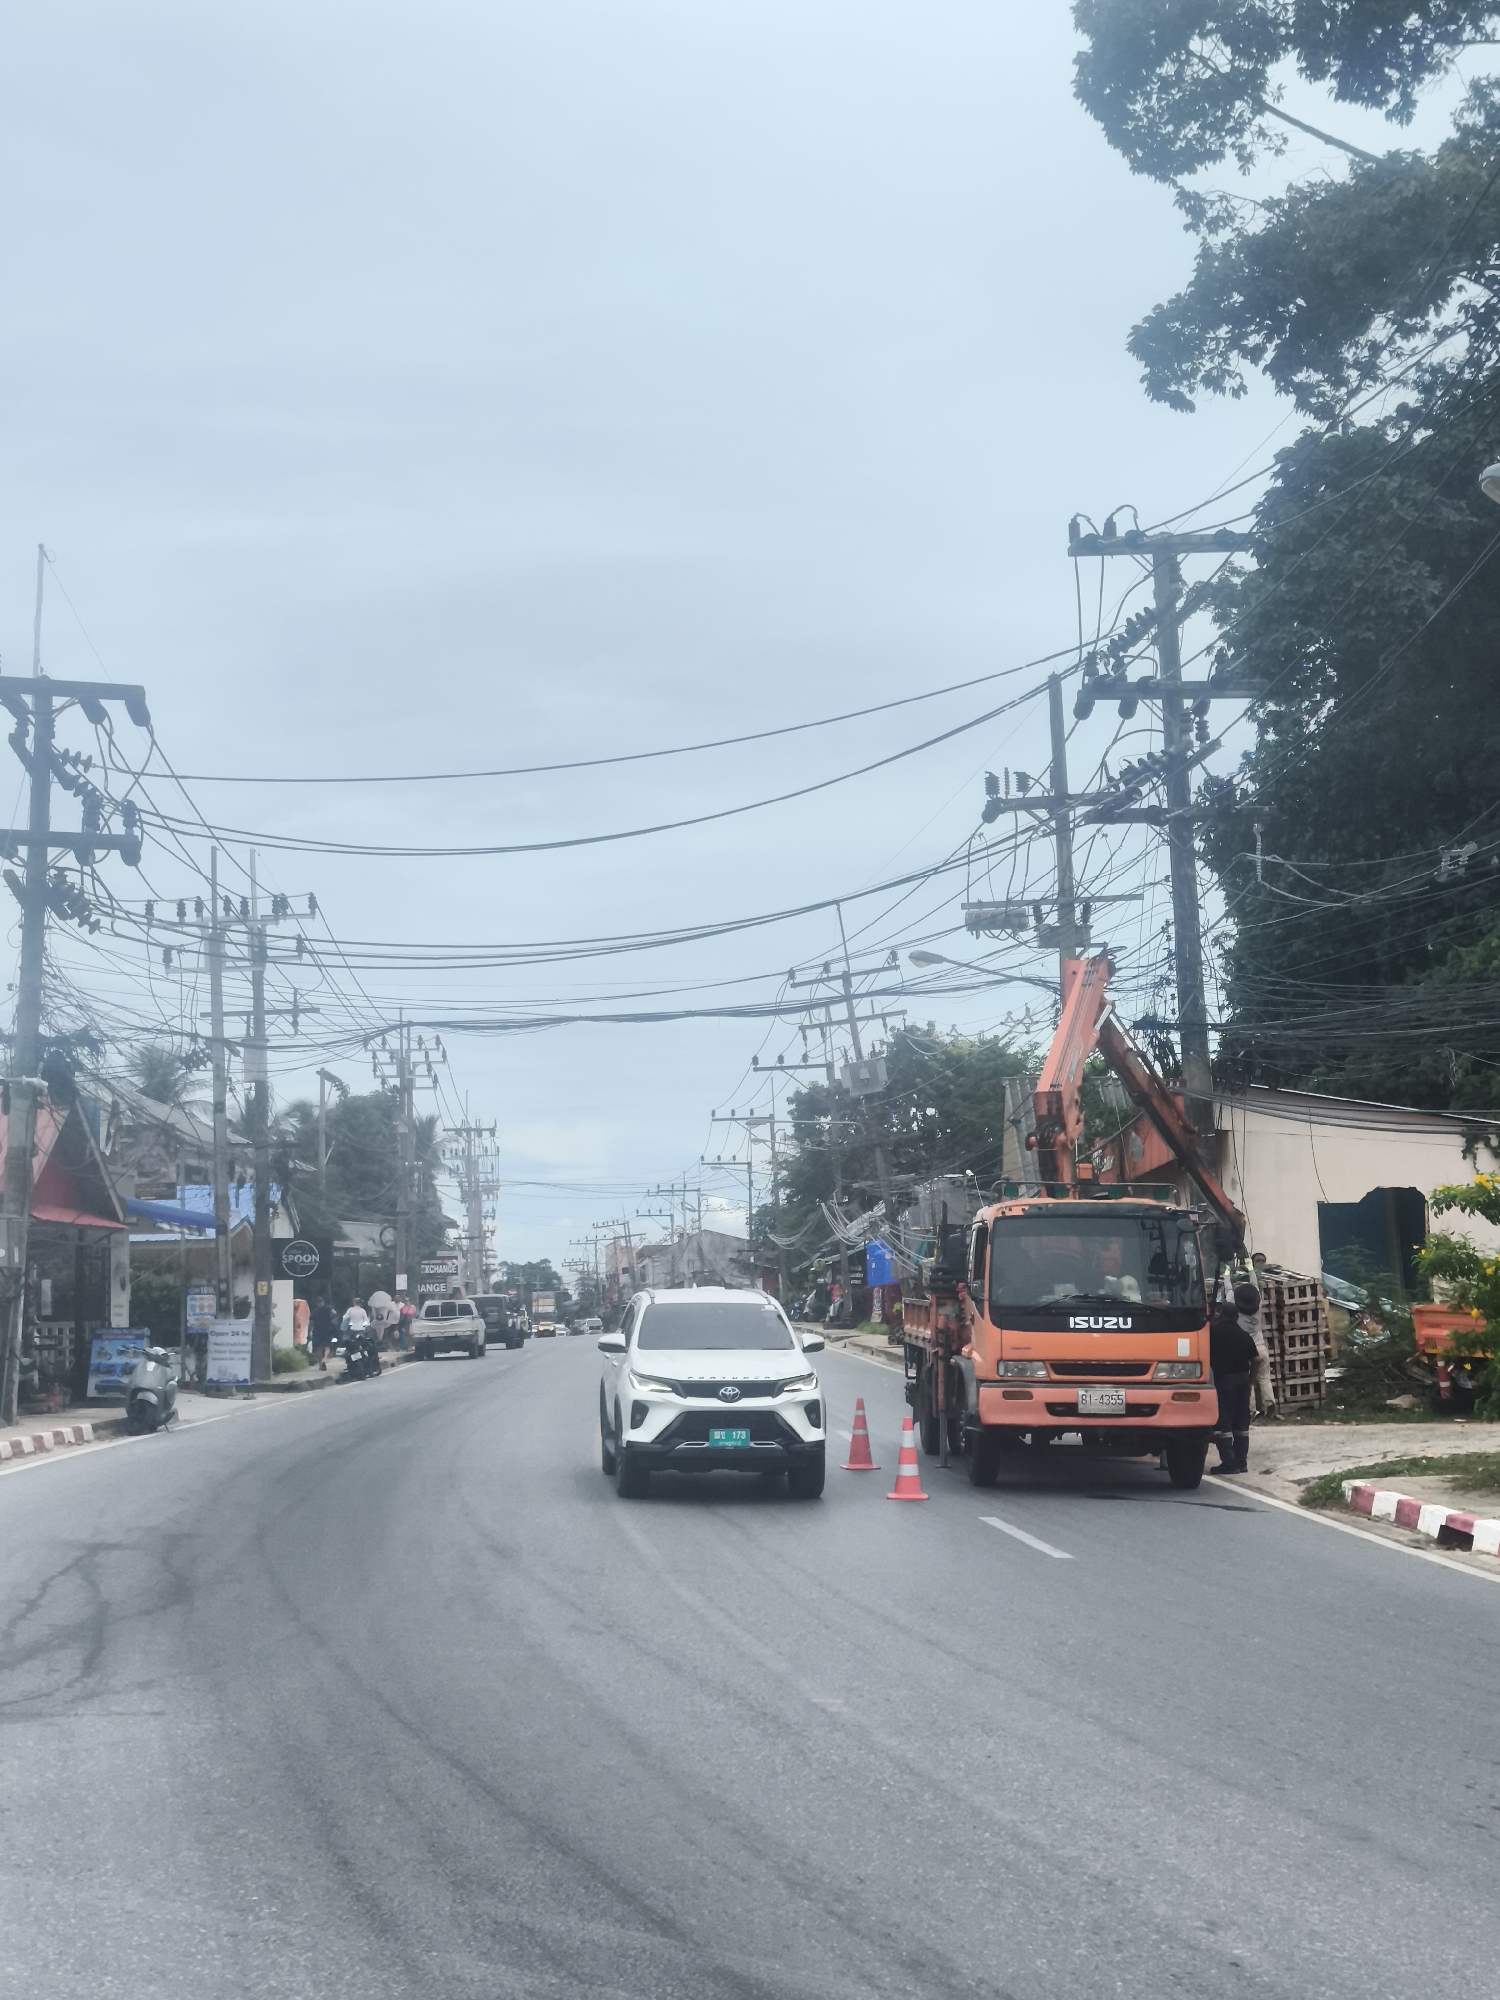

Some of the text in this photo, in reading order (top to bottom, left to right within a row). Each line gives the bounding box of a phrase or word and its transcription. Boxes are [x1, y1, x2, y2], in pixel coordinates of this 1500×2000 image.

[281, 1254, 320, 1264] SPOON
[1069, 1316, 1132, 1329] ISUZU
[1080, 1393, 1124, 1406] 81-4355
[732, 1430, 747, 1440] 173
